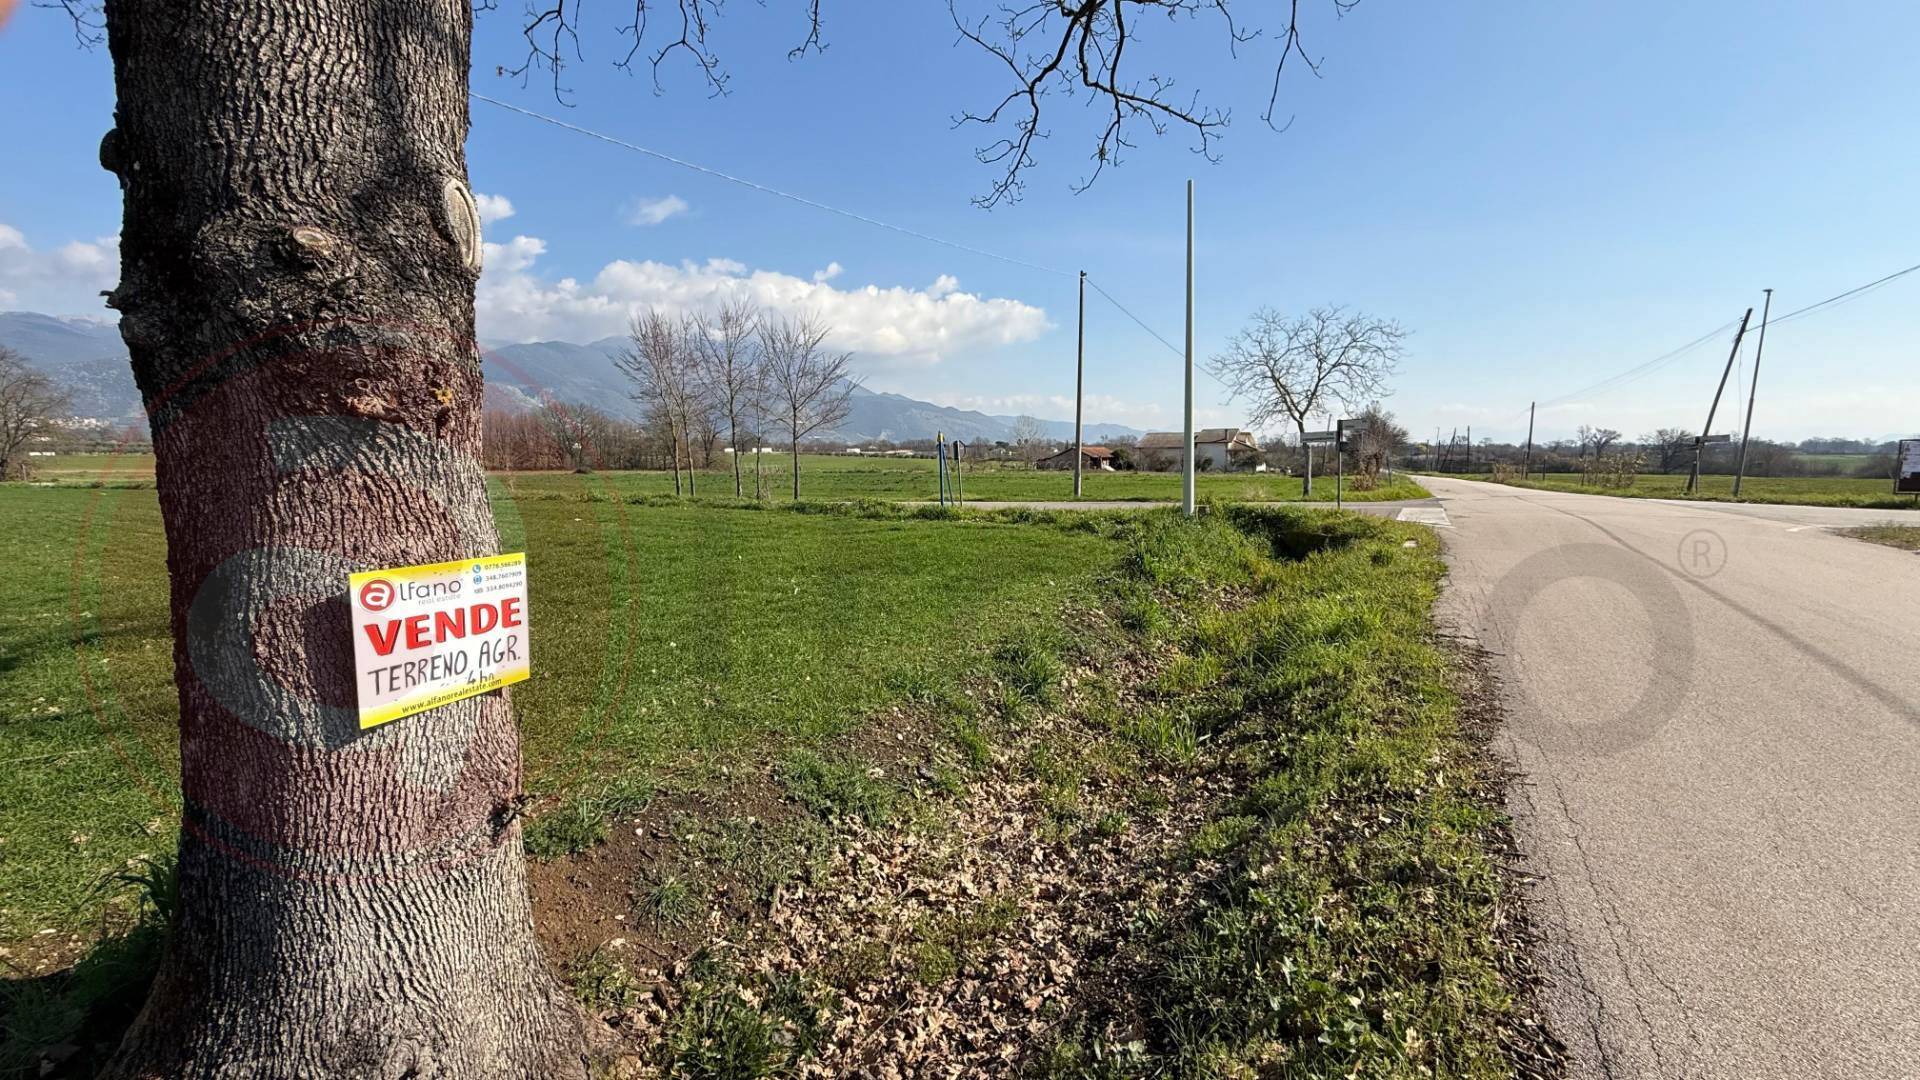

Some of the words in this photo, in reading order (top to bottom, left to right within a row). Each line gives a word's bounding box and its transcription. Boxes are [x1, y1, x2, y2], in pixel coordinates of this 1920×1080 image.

[418, 597, 435, 606] real
[437, 594, 462, 603] estate
[363, 597, 522, 656] VENDE
[368, 649, 467, 695] TERRENO
[479, 635, 521, 669] AGR.
[402, 678, 502, 713] www.alfanorealestate.com
